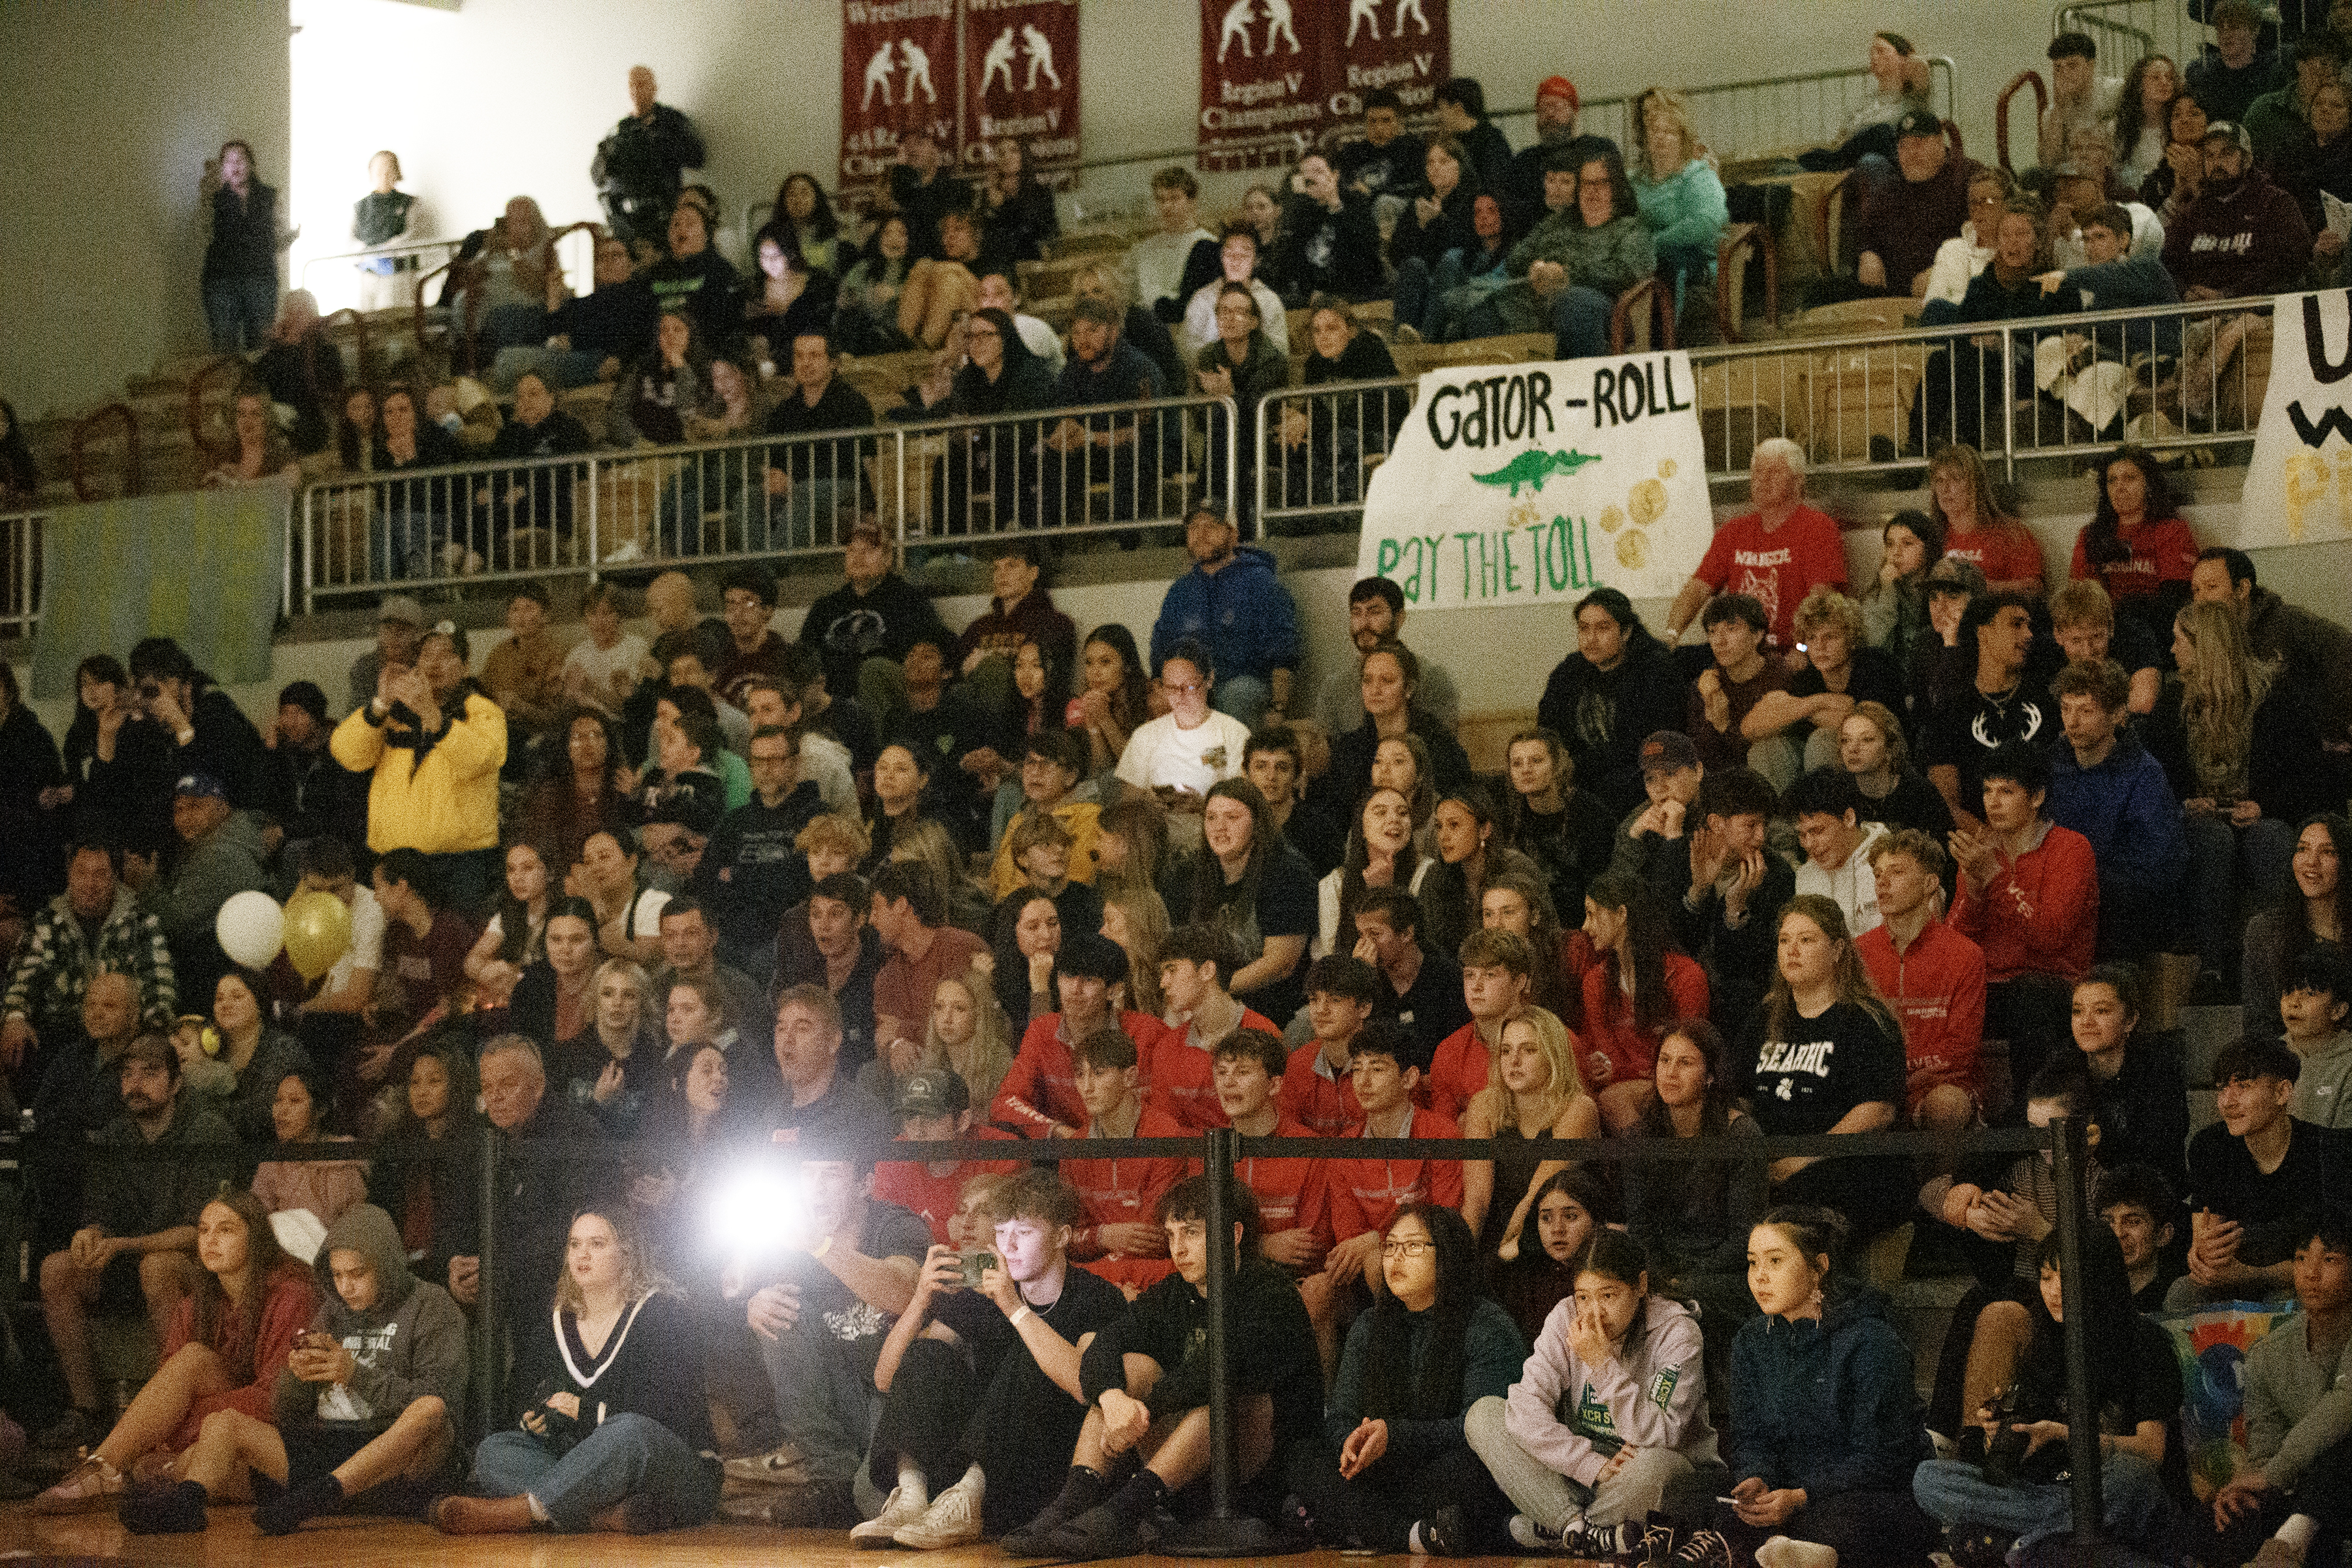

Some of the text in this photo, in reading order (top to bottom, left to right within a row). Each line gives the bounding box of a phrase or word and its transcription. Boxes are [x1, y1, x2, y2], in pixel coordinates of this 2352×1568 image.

[1284, 71, 1304, 94] V
[1347, 52, 1434, 89] Region V
[1046, 106, 1062, 131] V
[1454, 529, 1524, 599] THE
[1526, 514, 1604, 595] TOLL
